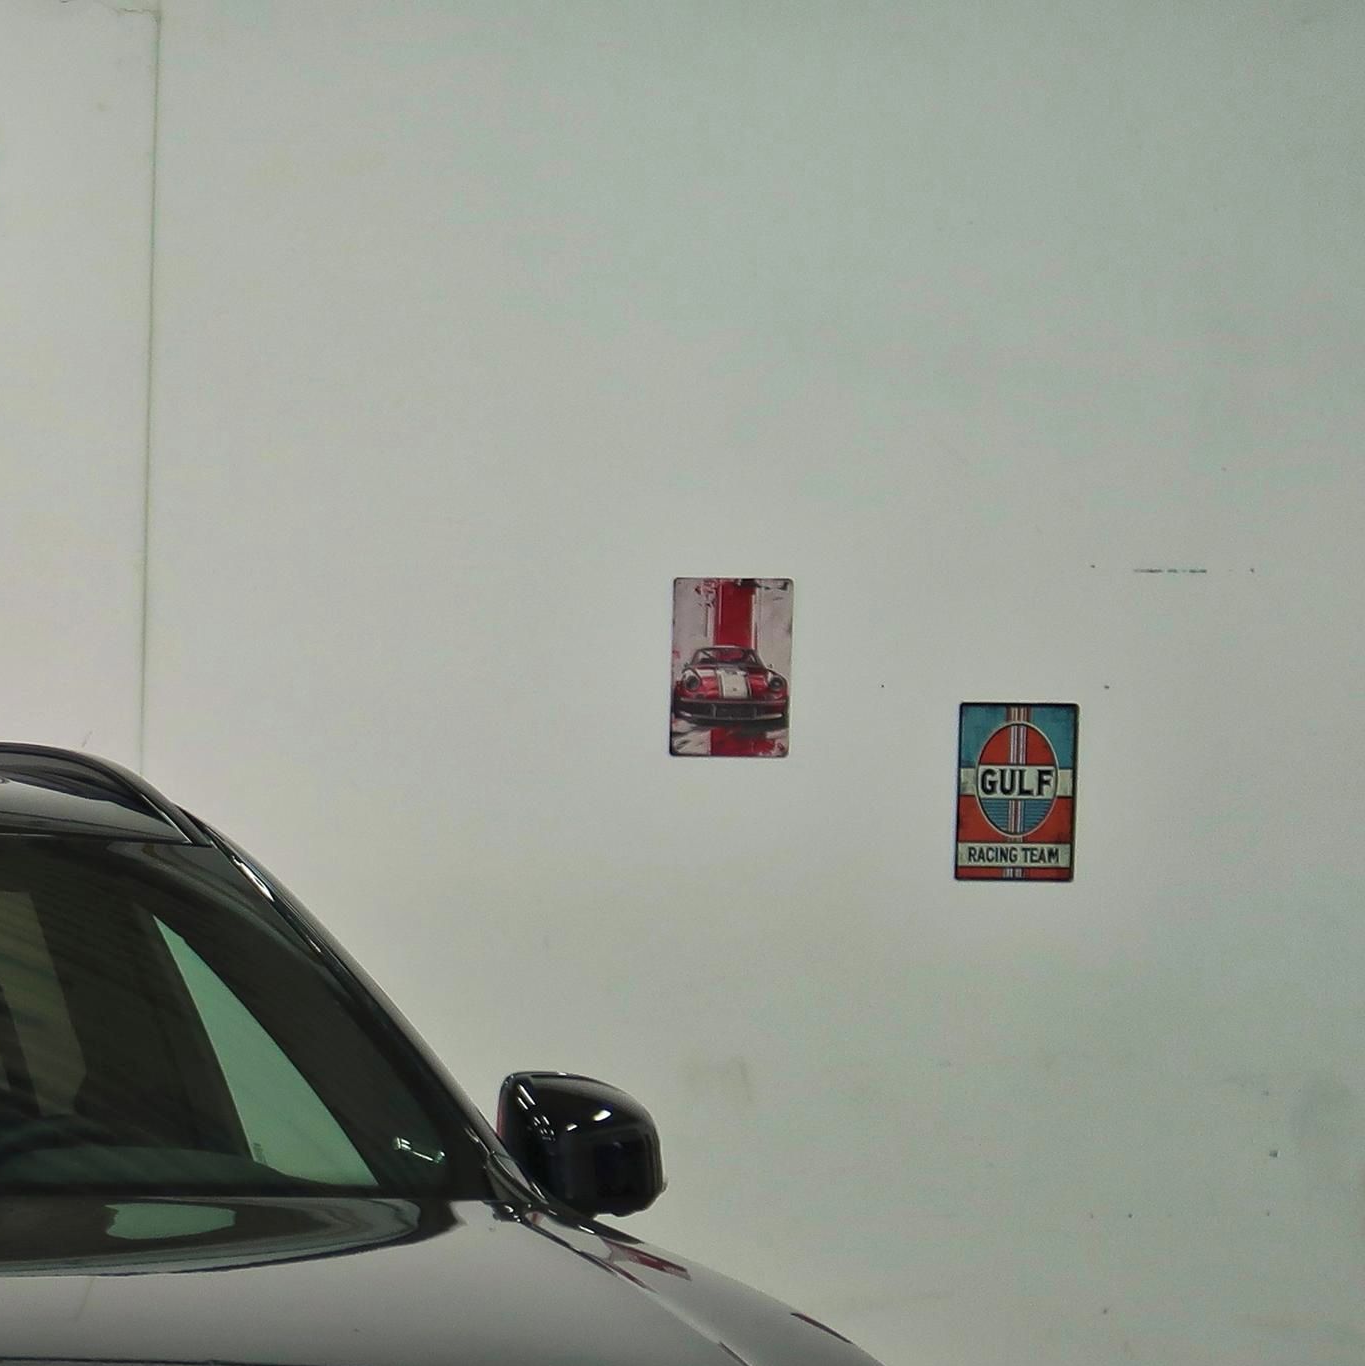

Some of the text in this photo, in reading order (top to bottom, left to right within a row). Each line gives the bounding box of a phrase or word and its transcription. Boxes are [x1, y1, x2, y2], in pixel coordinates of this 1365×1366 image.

[980, 768, 1054, 796] GULF
[968, 847, 1060, 864] RACING TEAM
